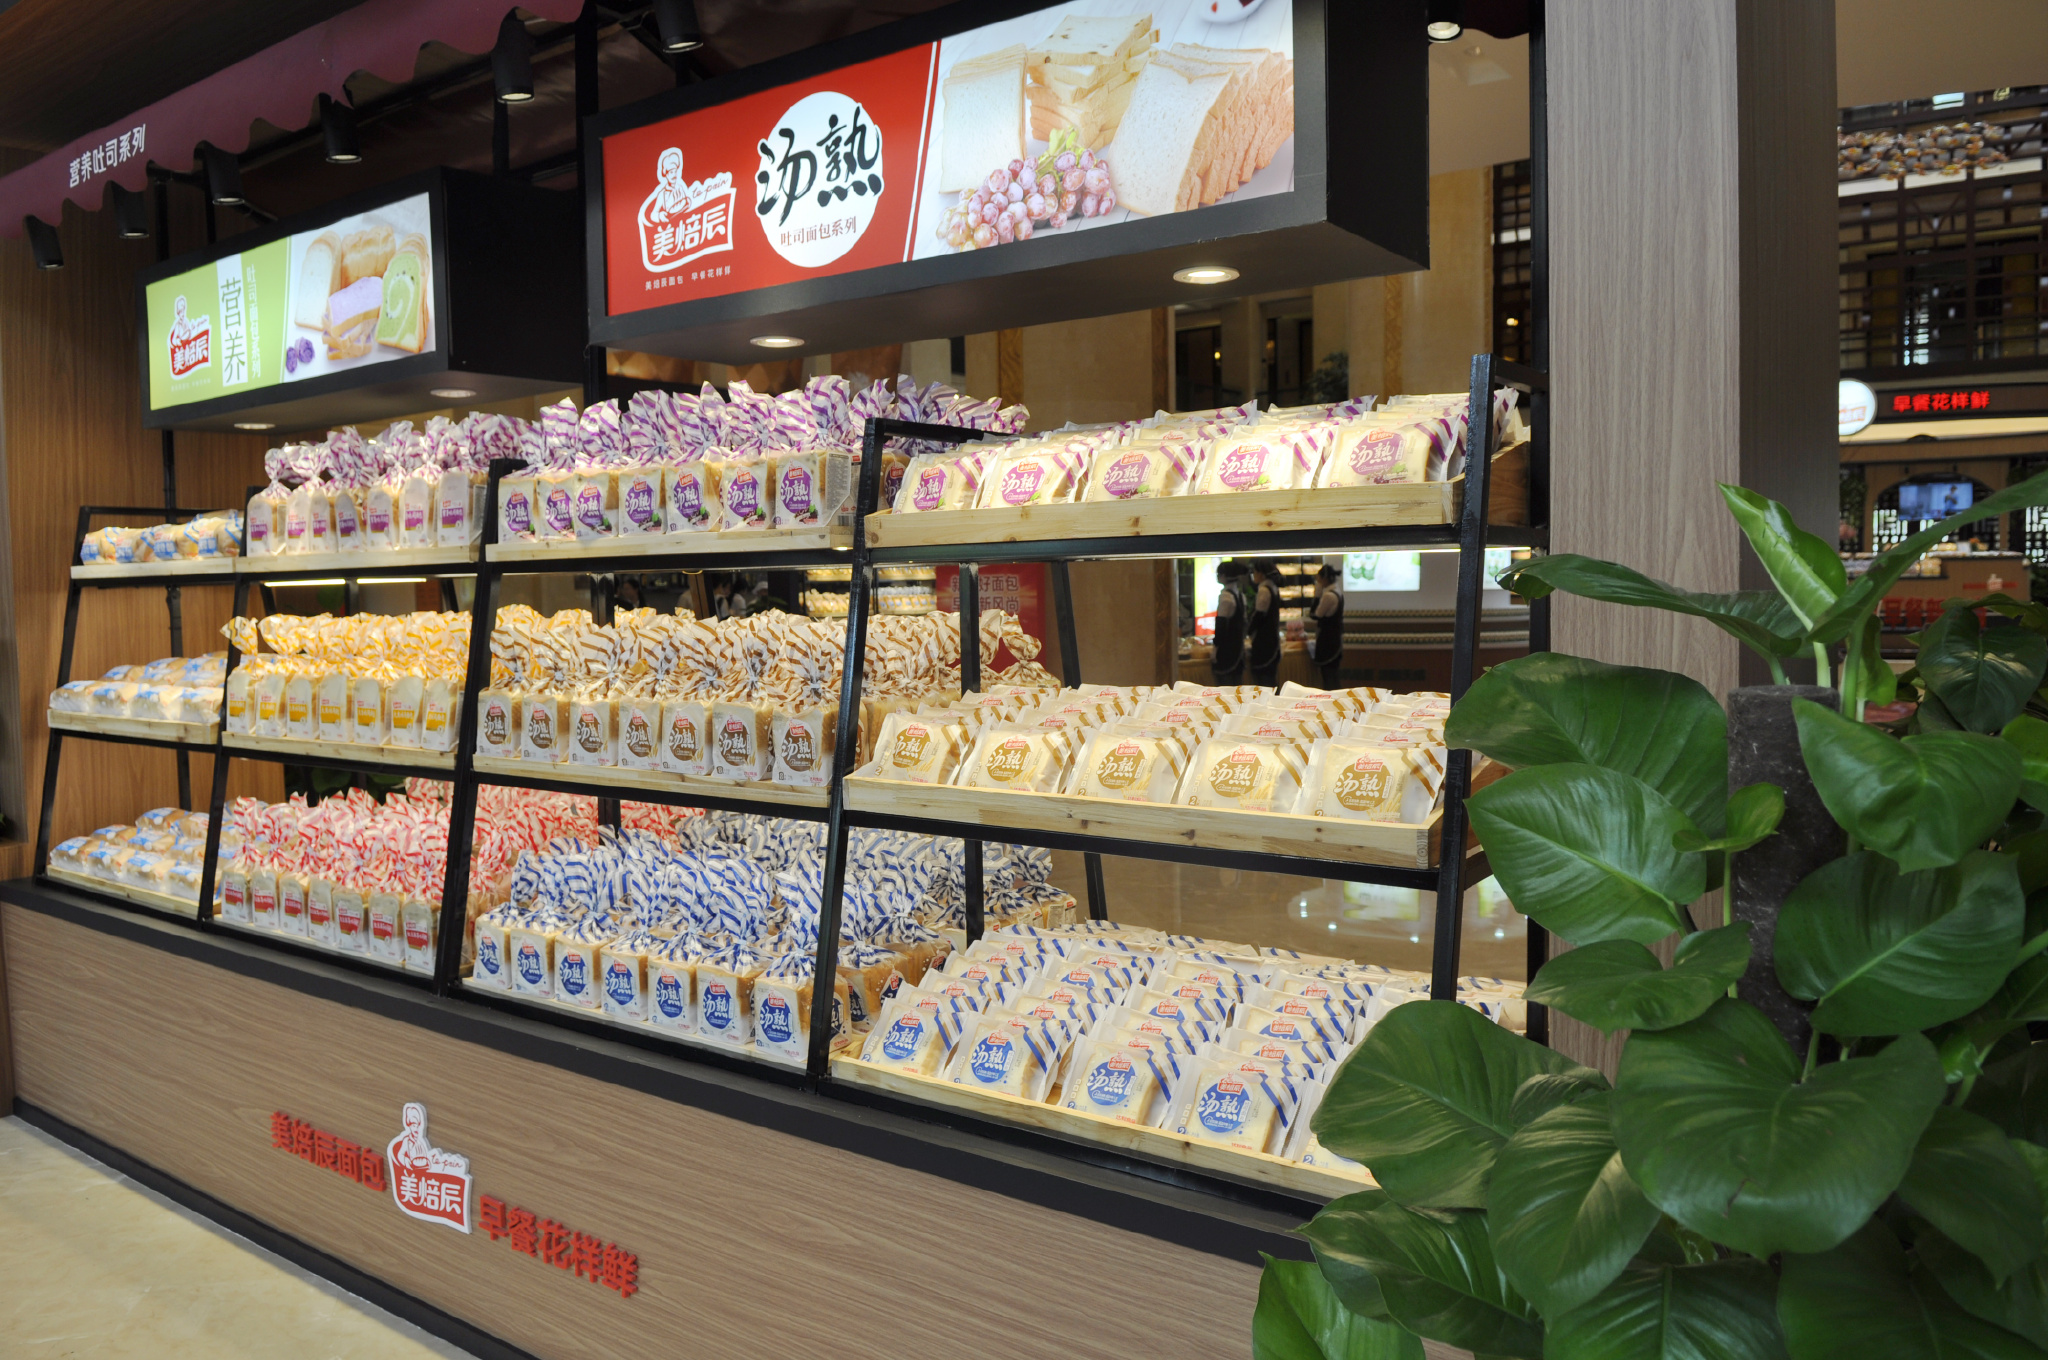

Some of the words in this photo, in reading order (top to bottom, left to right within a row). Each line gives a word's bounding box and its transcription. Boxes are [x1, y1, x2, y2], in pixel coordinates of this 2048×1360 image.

[70, 123, 146, 188] 营养吐司系列
[652, 203, 726, 262] 美焙辰
[780, 216, 857, 246] 吐司面包系列
[220, 277, 245, 383] 营养
[1893, 391, 1990, 413] 早餐花样鲜
[1333, 773, 1382, 797] 汤熟
[1086, 1069, 1127, 1094] 汤熟
[1197, 1091, 1240, 1121] 汤熟
[270, 1111, 387, 1192] 美焙辰面包
[400, 1169, 462, 1215] 美焙辰
[478, 1194, 638, 1298] 早餐花样鲜
